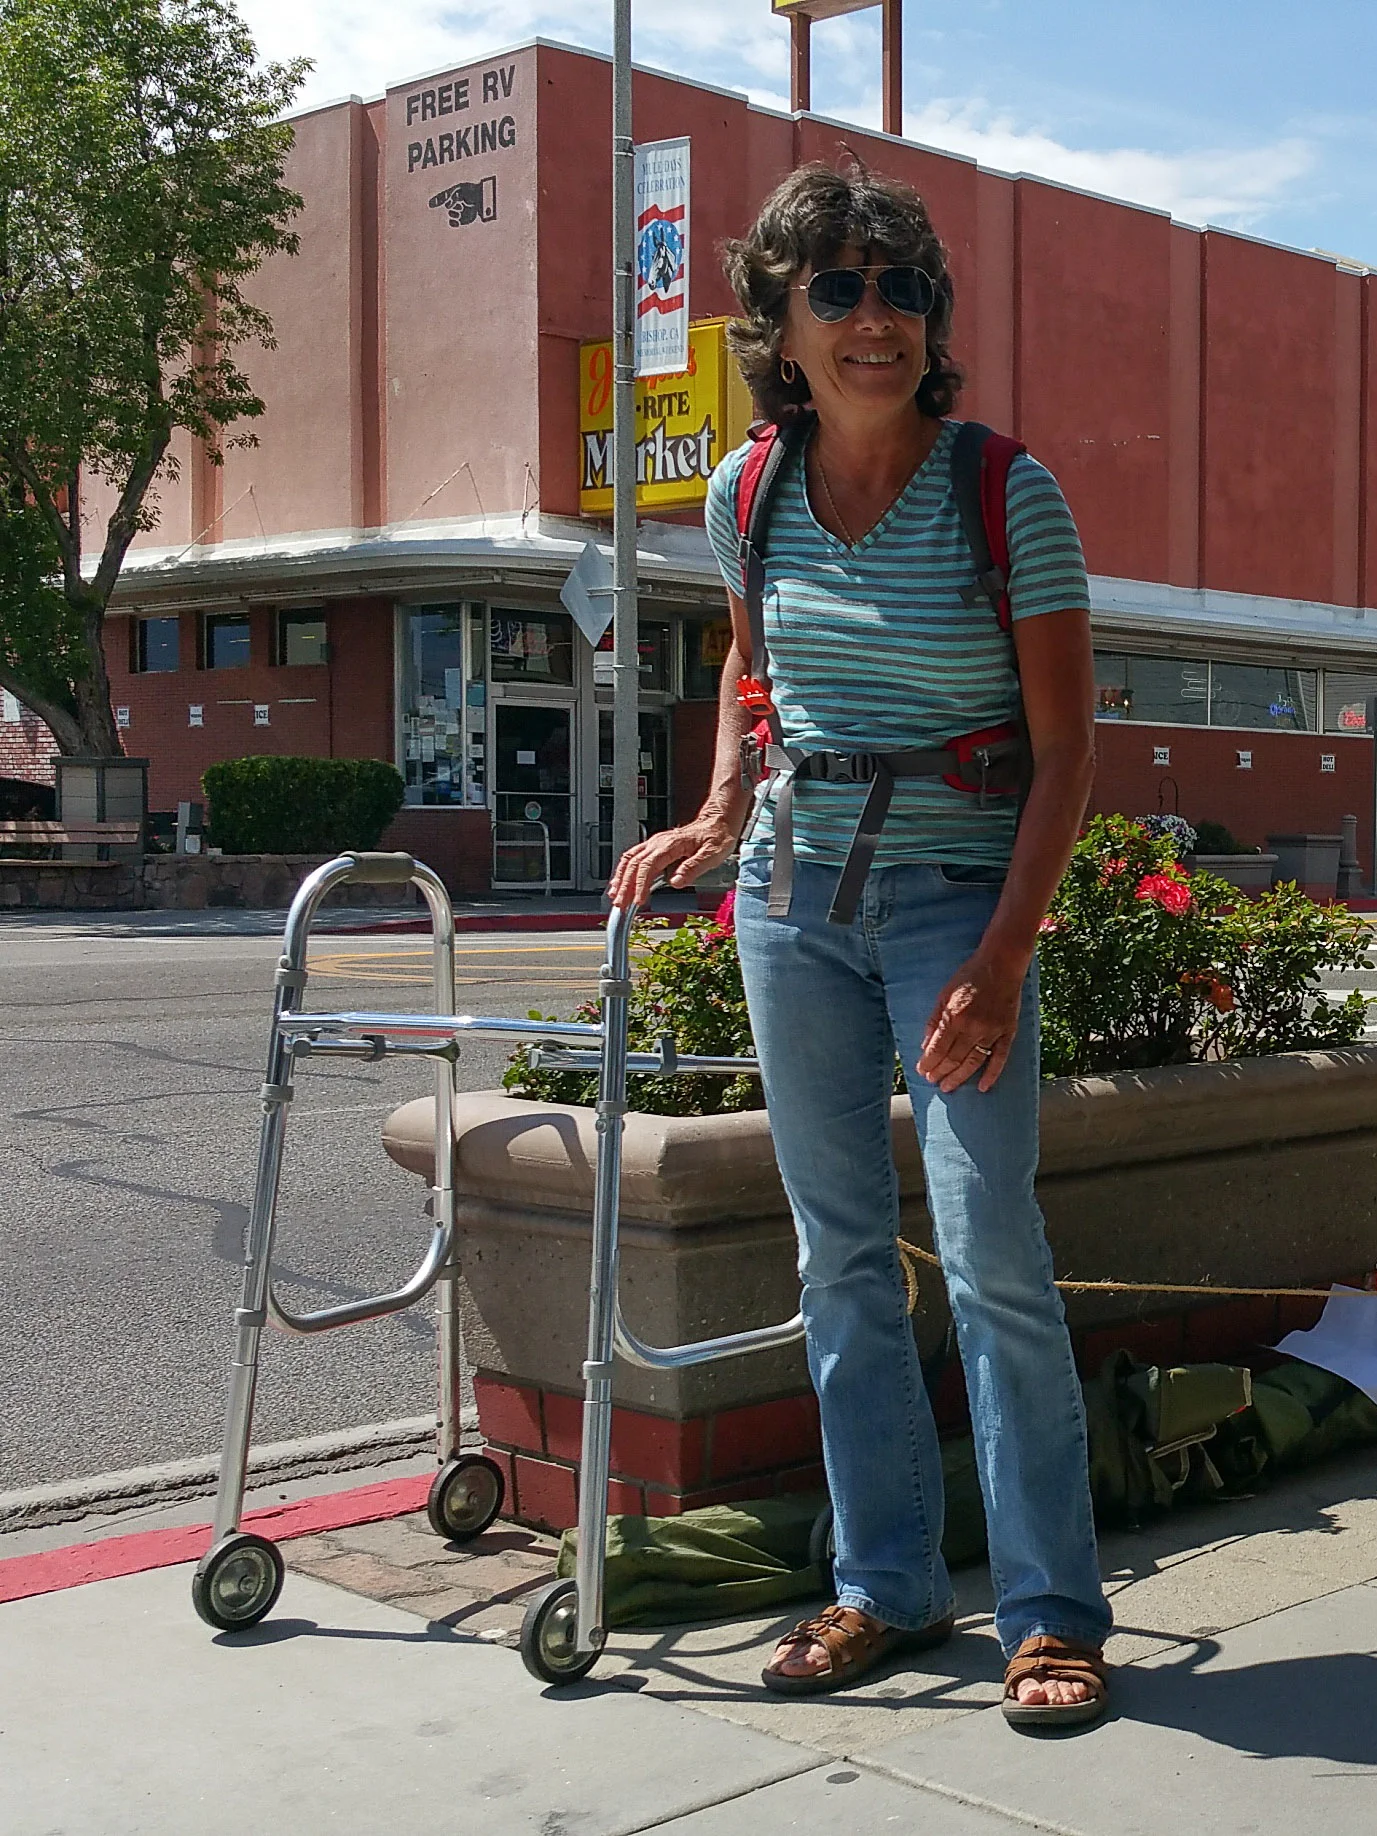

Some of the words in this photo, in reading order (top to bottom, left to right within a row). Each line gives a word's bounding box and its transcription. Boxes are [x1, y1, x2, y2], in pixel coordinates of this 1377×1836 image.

[406, 78, 469, 126] FREE
[483, 65, 515, 103] RV
[408, 116, 515, 173] PARKING
[642, 161, 662, 176] MULE
[664, 158, 682, 173] DAYS
[637, 176, 685, 194] CELEBRATION
[670, 327, 680, 340] CA
[583, 414, 716, 490] Mrket
[256, 710, 268, 719] ICE
[1155, 752, 1169, 760] ICE
